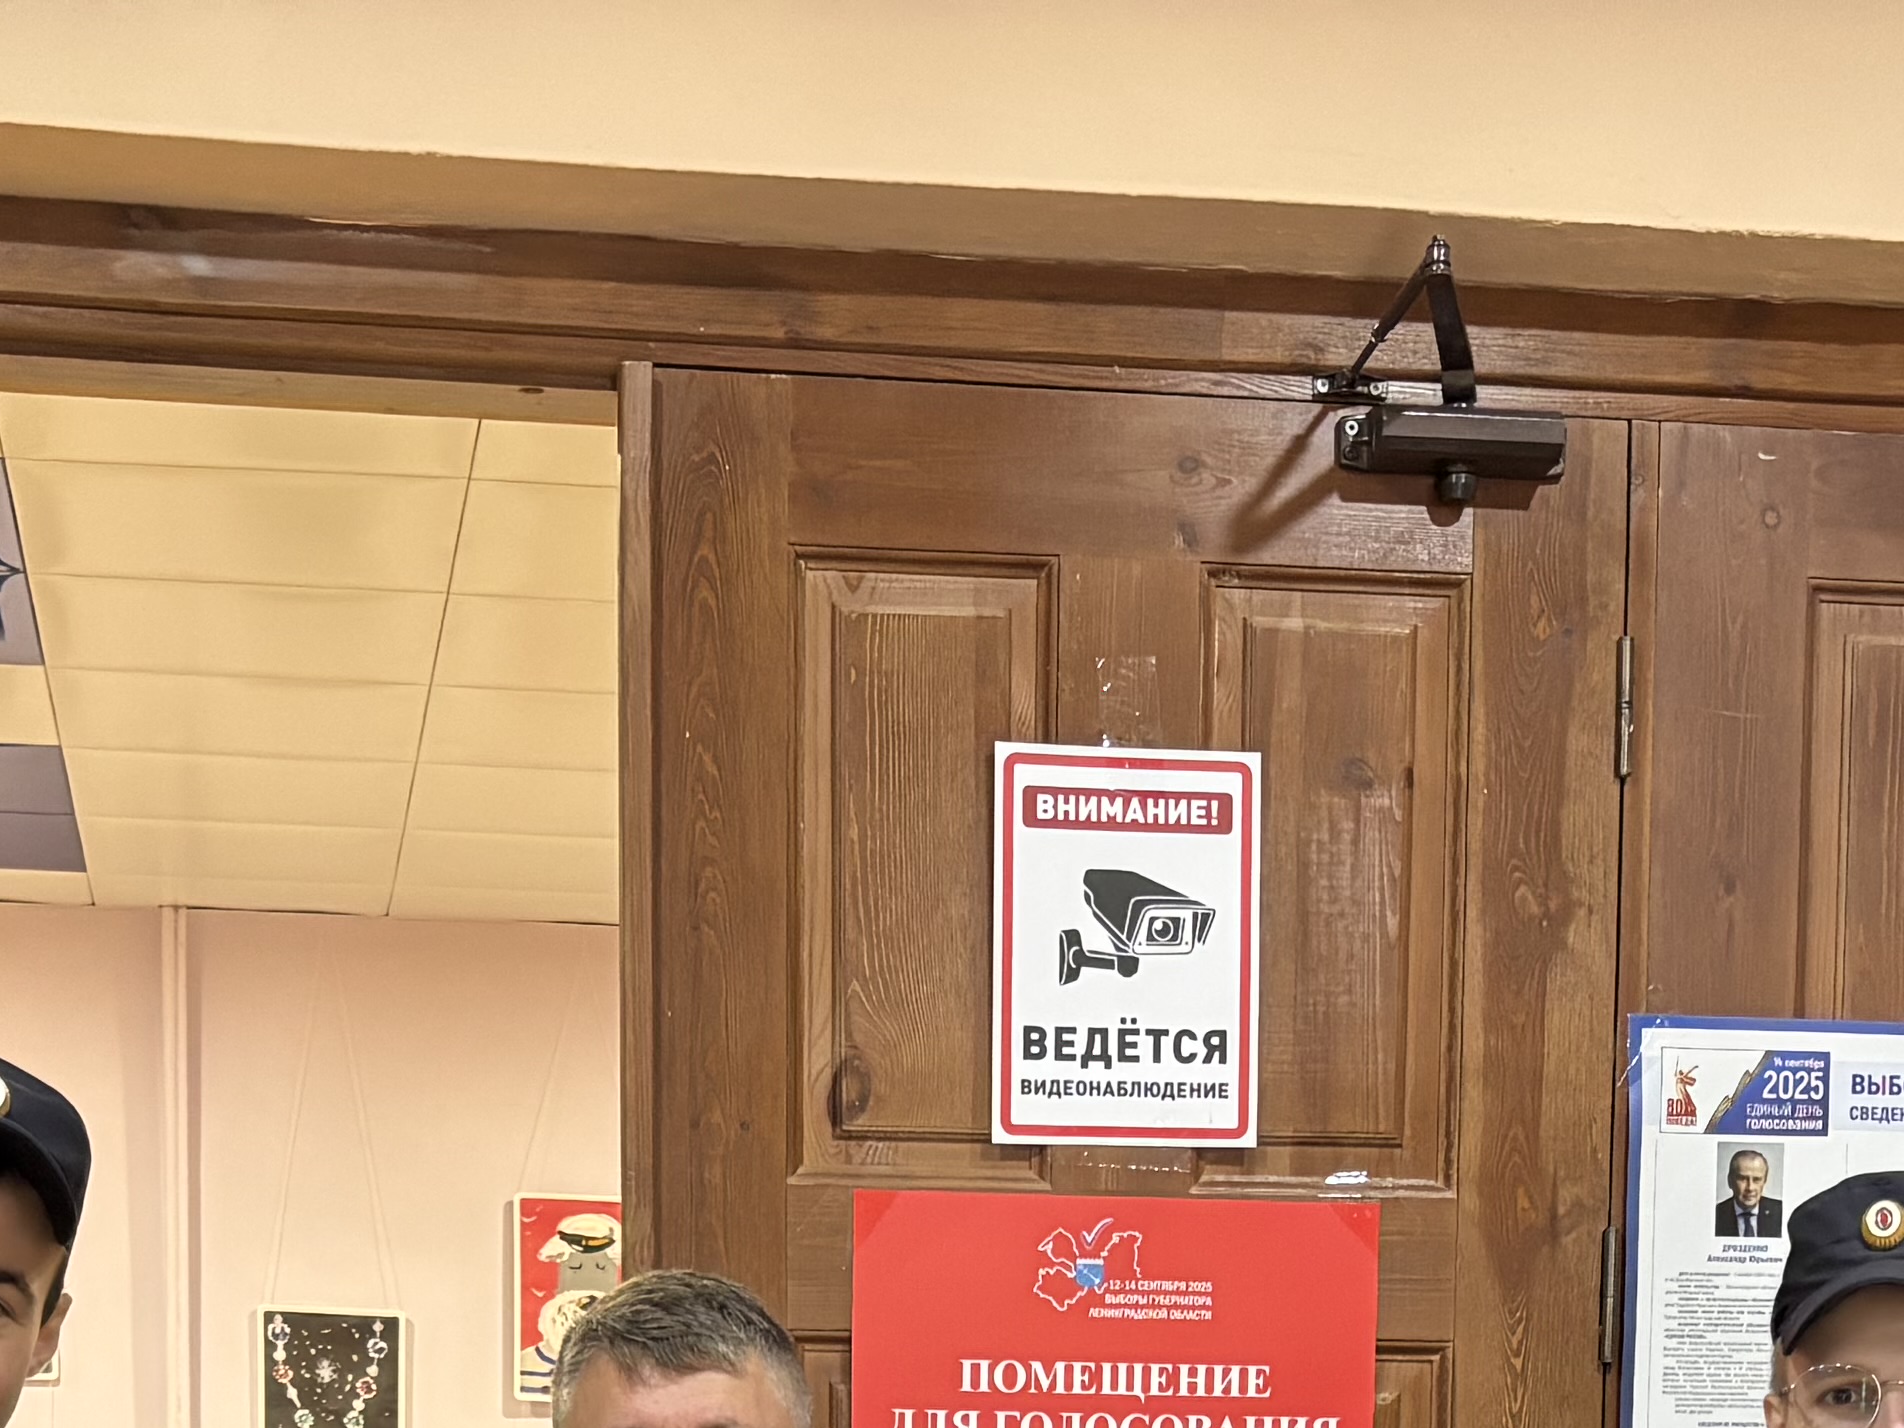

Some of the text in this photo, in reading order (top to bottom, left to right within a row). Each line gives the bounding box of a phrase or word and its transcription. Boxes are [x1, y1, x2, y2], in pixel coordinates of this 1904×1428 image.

[1035, 792, 1220, 827] ВНИМАНИЕ!
[1022, 1016, 1228, 1070] ВЕДЁТСЯ
[1020, 1078, 1230, 1101] ВИДЕОНАБЛЮДЕНИЕ
[1762, 1069, 1824, 1100] 2025
[1746, 1101, 1824, 1118] ЕДИНЫЙ ДЕНЬ
[958, 1358, 1271, 1403] ПОМЕЩЕНИЕ
